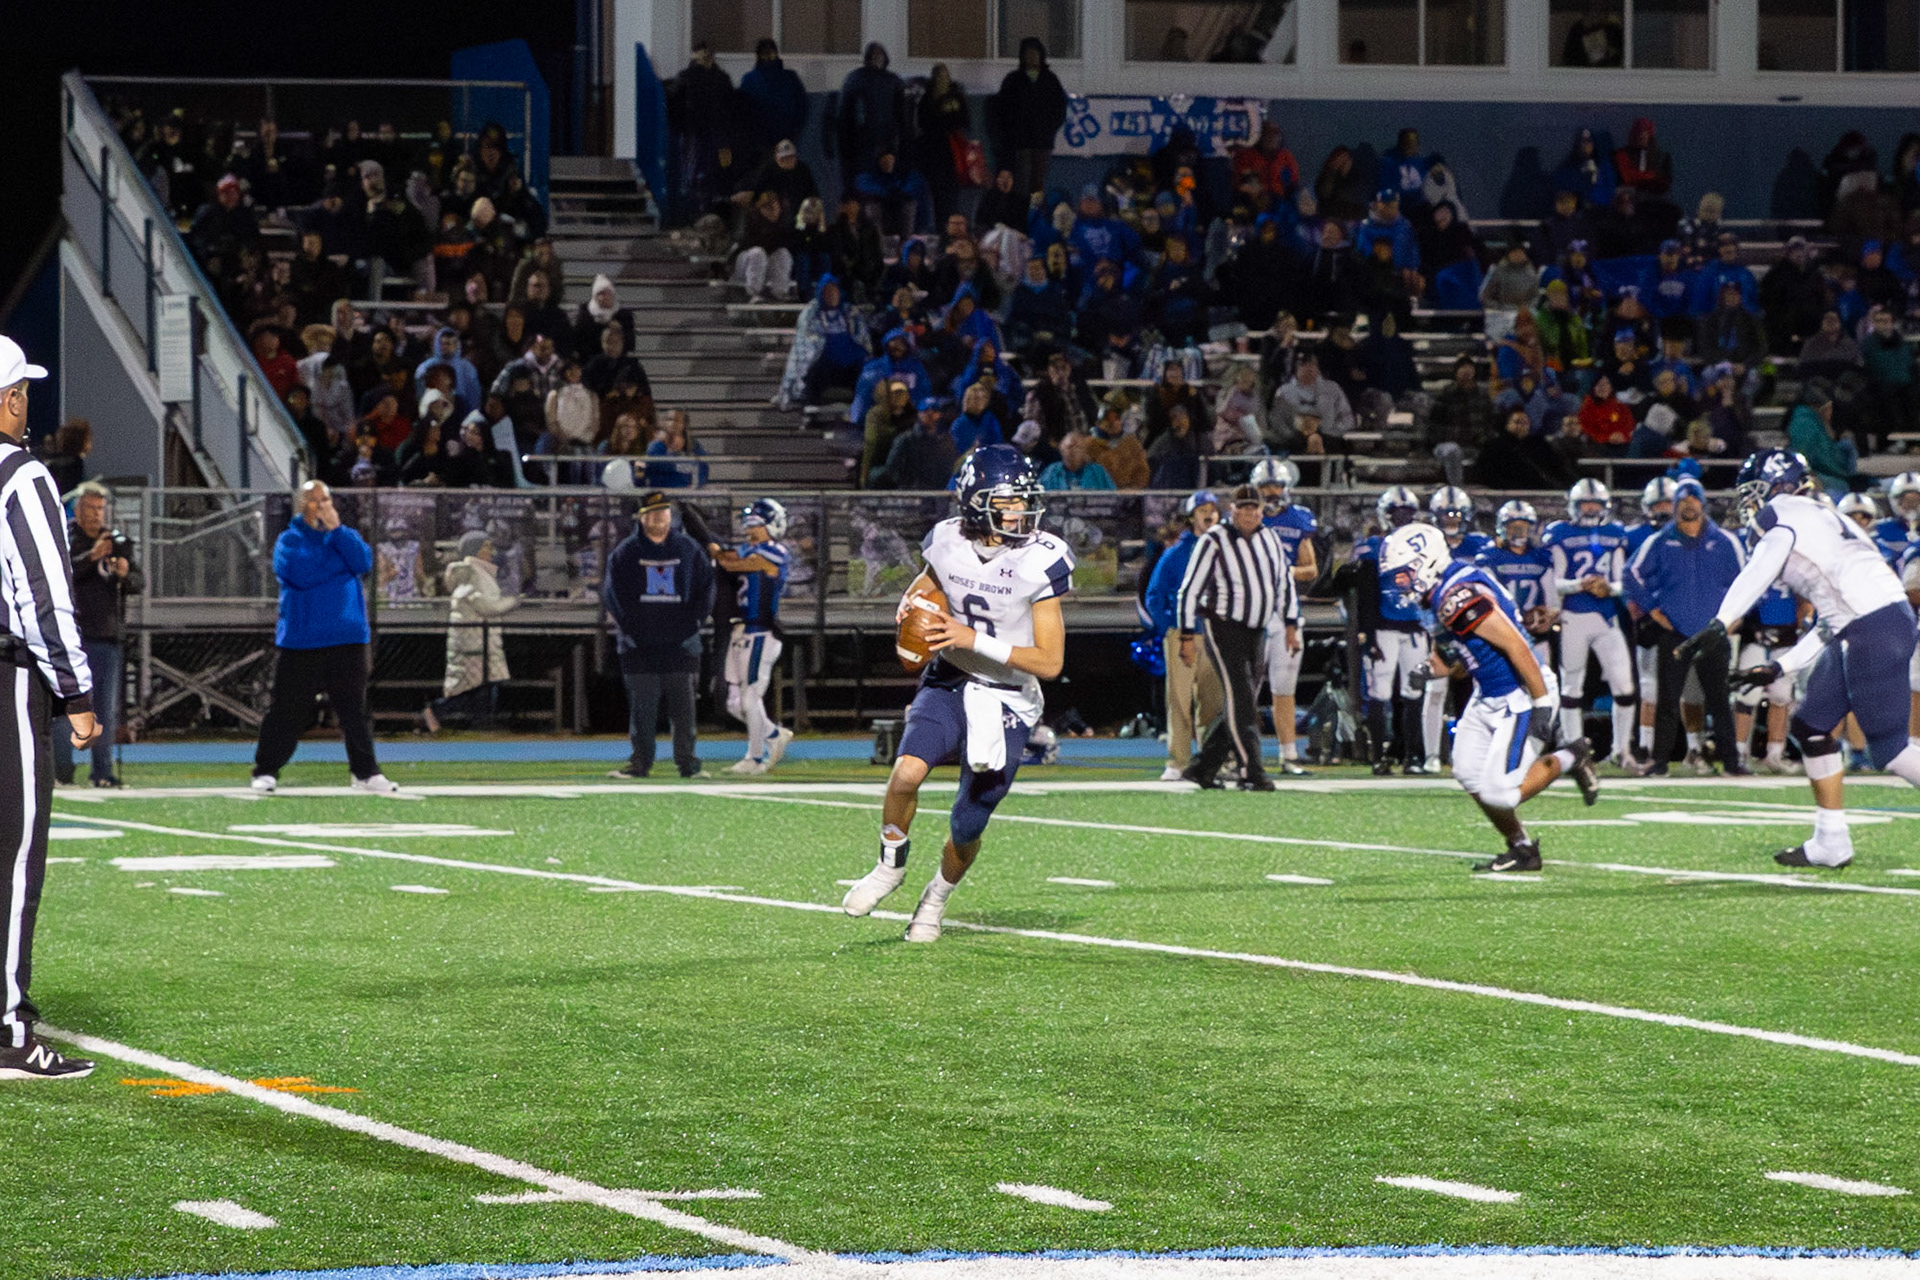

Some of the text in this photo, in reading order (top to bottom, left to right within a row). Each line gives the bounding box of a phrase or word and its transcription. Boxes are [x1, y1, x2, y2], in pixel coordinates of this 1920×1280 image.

[1406, 533, 1427, 553] 57
[1572, 550, 1612, 584] 24
[948, 573, 1012, 596] MOSES BROWN
[962, 593, 997, 638] 6
